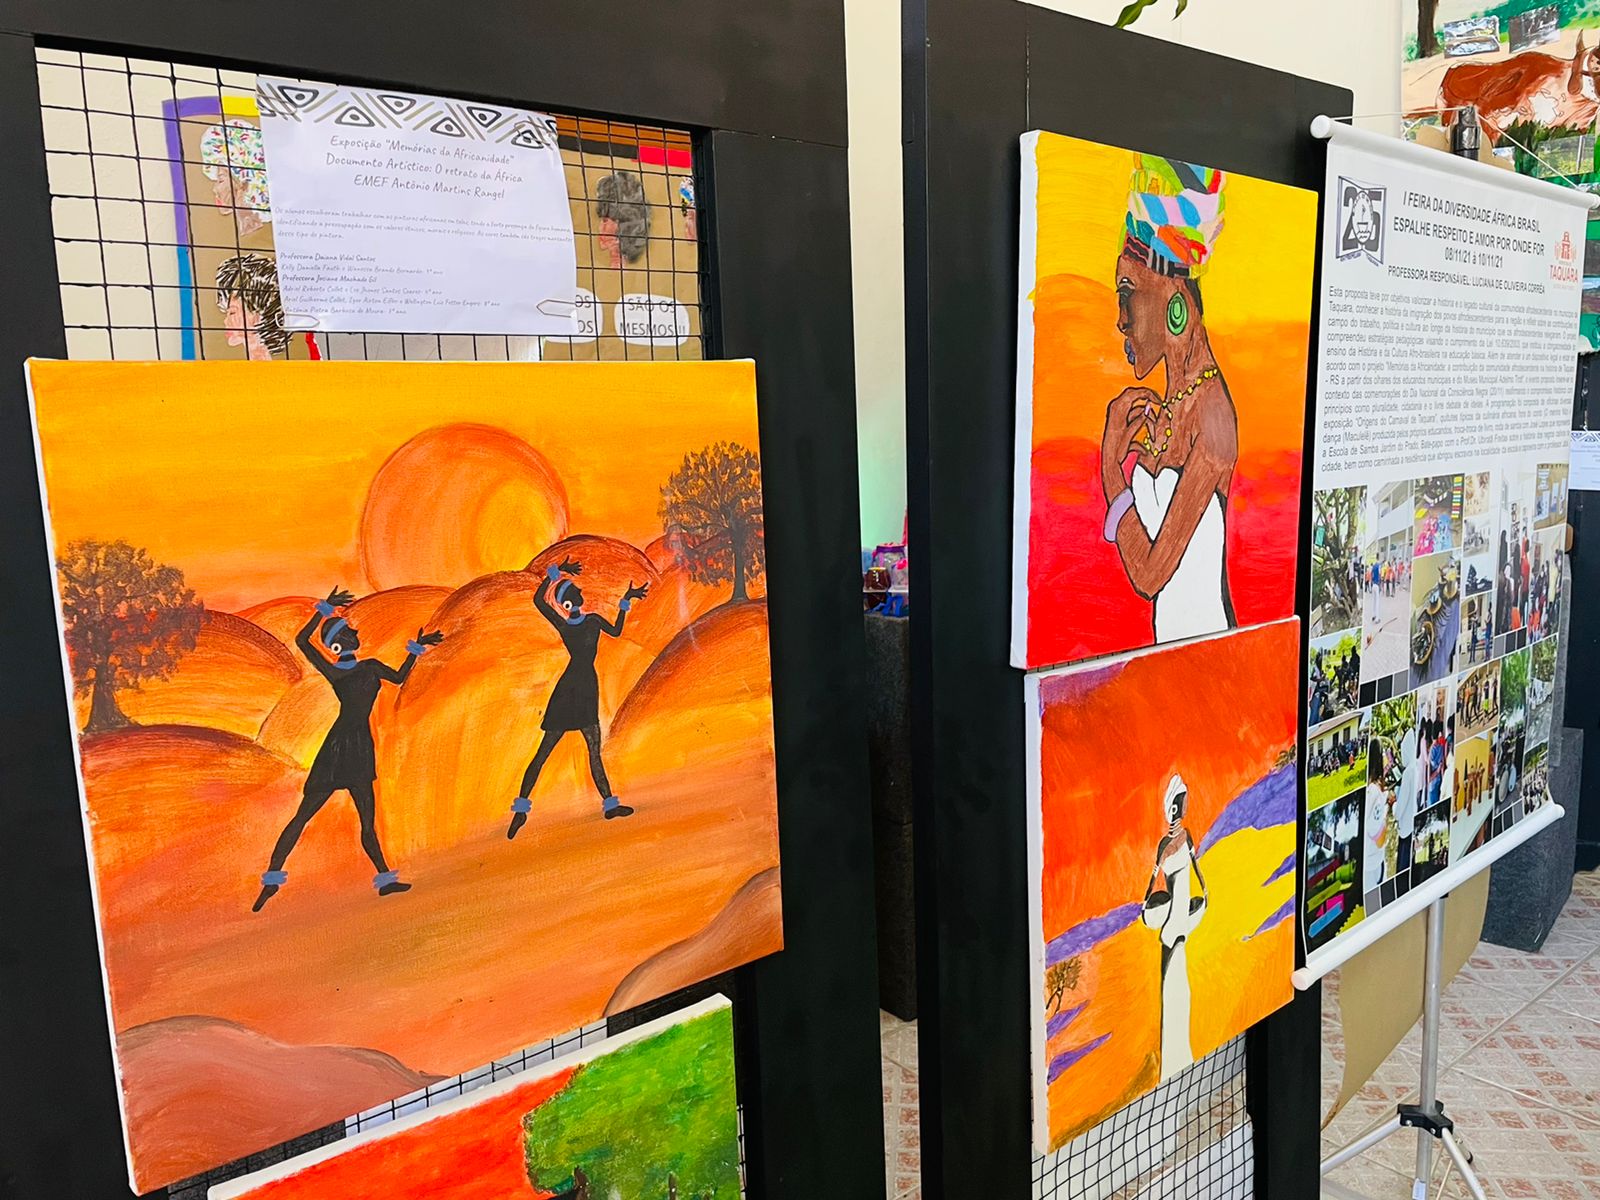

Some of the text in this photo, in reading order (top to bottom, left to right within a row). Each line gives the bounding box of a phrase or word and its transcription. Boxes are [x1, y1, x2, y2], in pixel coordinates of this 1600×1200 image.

[330, 135, 515, 165] Exposição "Memórias da Africanidade"
[326, 152, 383, 168] Documento
[435, 163, 442, 174] O
[445, 166, 478, 179] retrato
[481, 170, 492, 180] da
[494, 168, 523, 183] África
[354, 174, 505, 200] EMEF Antônio Martins Rangel
[1408, 192, 1431, 210] FEIRA
[1432, 197, 1444, 213] DA
[1445, 200, 1492, 224] DIVERSIDADE
[1492, 208, 1516, 228] ÁFRICA
[1518, 216, 1541, 234] BRASIL
[1393, 216, 1545, 258] ESPALHE RESPEITO E AMOR POR ONDE FOR
[280, 252, 314, 261] Professora
[339, 253, 354, 261] Vidal
[356, 254, 376, 262] Santos
[1444, 246, 1471, 264] 08/11/21
[1478, 252, 1504, 269] 10/11/21
[282, 274, 315, 282] Professora
[340, 275, 368, 283] Machado
[1388, 265, 1428, 281] PROFESSORA
[1430, 270, 1472, 286] RESPONSÁVEL:
[1472, 276, 1494, 289] LUCIANA
[1495, 280, 1503, 290] DE
[1504, 280, 1527, 292] OLIVEIRA
[1550, 264, 1578, 283] TAQUARA
[1328, 286, 1344, 298] Esta
[1344, 289, 1369, 300] proposta
[1370, 291, 1380, 301] teve
[1381, 293, 1390, 302] por
[628, 296, 676, 314] SÃO OS
[1328, 300, 1354, 314] Taquara,
[1356, 304, 1380, 314] conhecer
[1384, 306, 1402, 317] história
[1328, 318, 1348, 329] campo
[1350, 318, 1358, 328] do
[1360, 318, 1382, 330] trabalho,
[1382, 320, 1400, 331] política
[1405, 322, 1421, 332] cultura
[1326, 332, 1366, 344] compreendeu
[1368, 334, 1395, 346] estratégias
[1326, 346, 1347, 356] ensino
[1348, 347, 1356, 356] da
[1358, 347, 1378, 357] História
[1392, 346, 1408, 358] Cultura
[1326, 361, 1347, 372] acordo
[1348, 362, 1360, 372] com
[1368, 362, 1385, 374] projeto
[1330, 374, 1340, 386] RS
[1347, 376, 1362, 388] partir
[1363, 376, 1373, 385] dos
[1392, 376, 1402, 385] dos
[1324, 390, 1350, 400] contexto
[1352, 390, 1362, 400] das
[1324, 402, 1353, 416] princípios
[1354, 404, 1371, 414] como
[1324, 418, 1354, 431] exposição
[1380, 416, 1386, 426] do
[1322, 432, 1342, 446] dança
[1372, 430, 1396, 442] produzida
[1322, 450, 1327, 458] a
[1328, 446, 1349, 458] Escola
[1350, 446, 1358, 456] de
[1359, 444, 1379, 455] Samba
[1322, 461, 1342, 473] cidade,
[1344, 460, 1357, 471] bem
[1358, 458, 1373, 470] como
